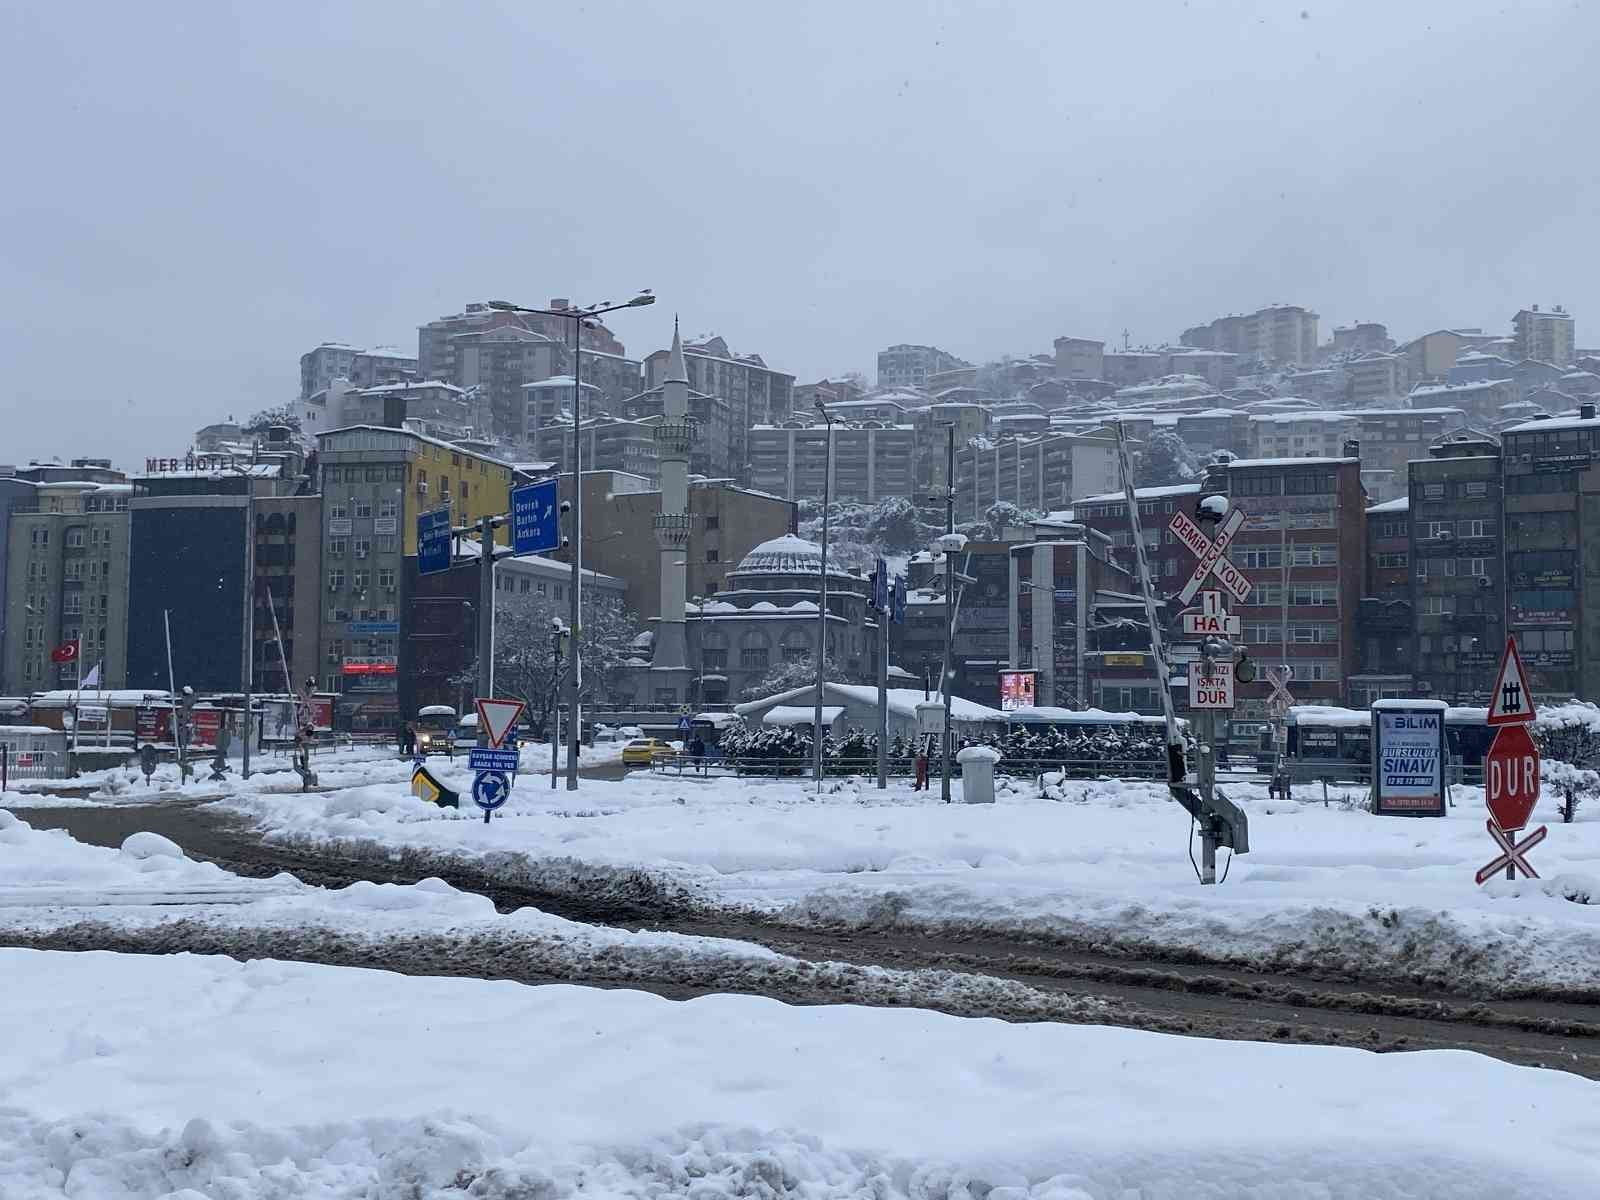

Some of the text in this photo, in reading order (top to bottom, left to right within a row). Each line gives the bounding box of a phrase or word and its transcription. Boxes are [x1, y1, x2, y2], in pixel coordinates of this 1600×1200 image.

[146, 455, 237, 472] MER HOTEL
[517, 527, 541, 538] Ankara
[1221, 563, 1248, 596] YOLU
[1208, 593, 1217, 615] 1
[1197, 690, 1228, 704] DUR
[1383, 759, 1435, 773] SINAVI
[1490, 755, 1535, 800] DUR
